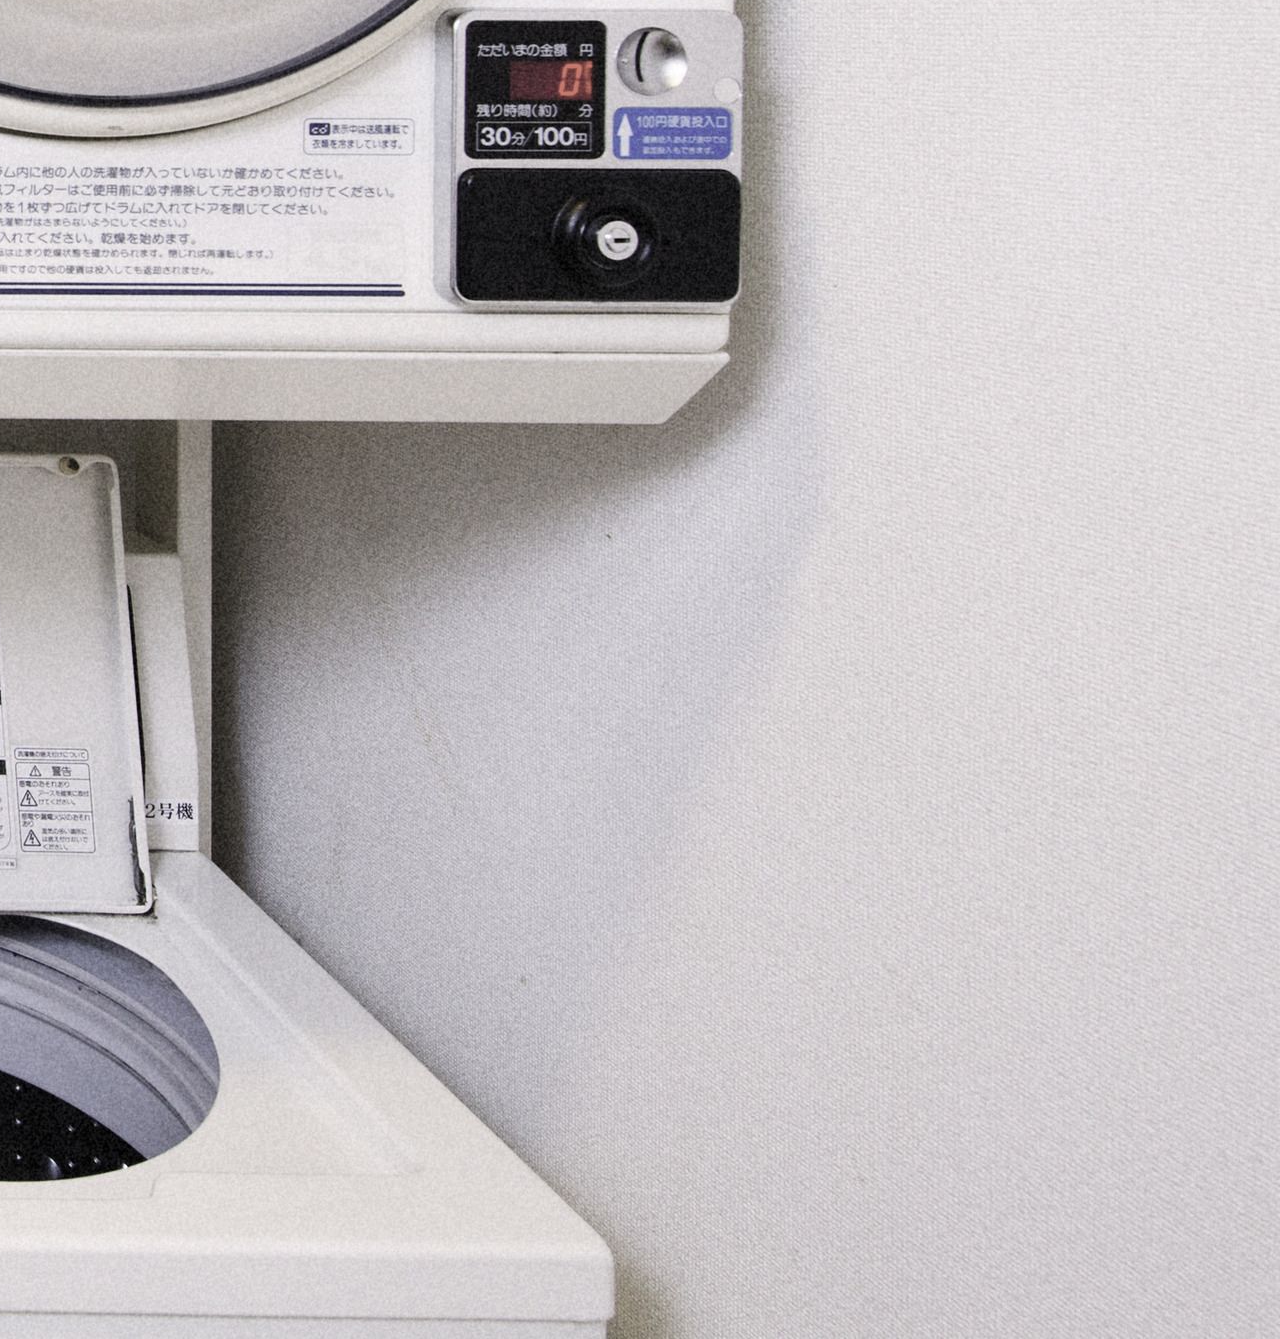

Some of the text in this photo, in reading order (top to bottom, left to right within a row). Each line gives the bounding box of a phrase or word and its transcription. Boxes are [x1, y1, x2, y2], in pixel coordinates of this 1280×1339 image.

[477, 43, 593, 58] ただいまの金額 円
[579, 104, 593, 118] 分
[480, 126, 588, 147] 30分/100円
[145, 802, 195, 820] 2号機
